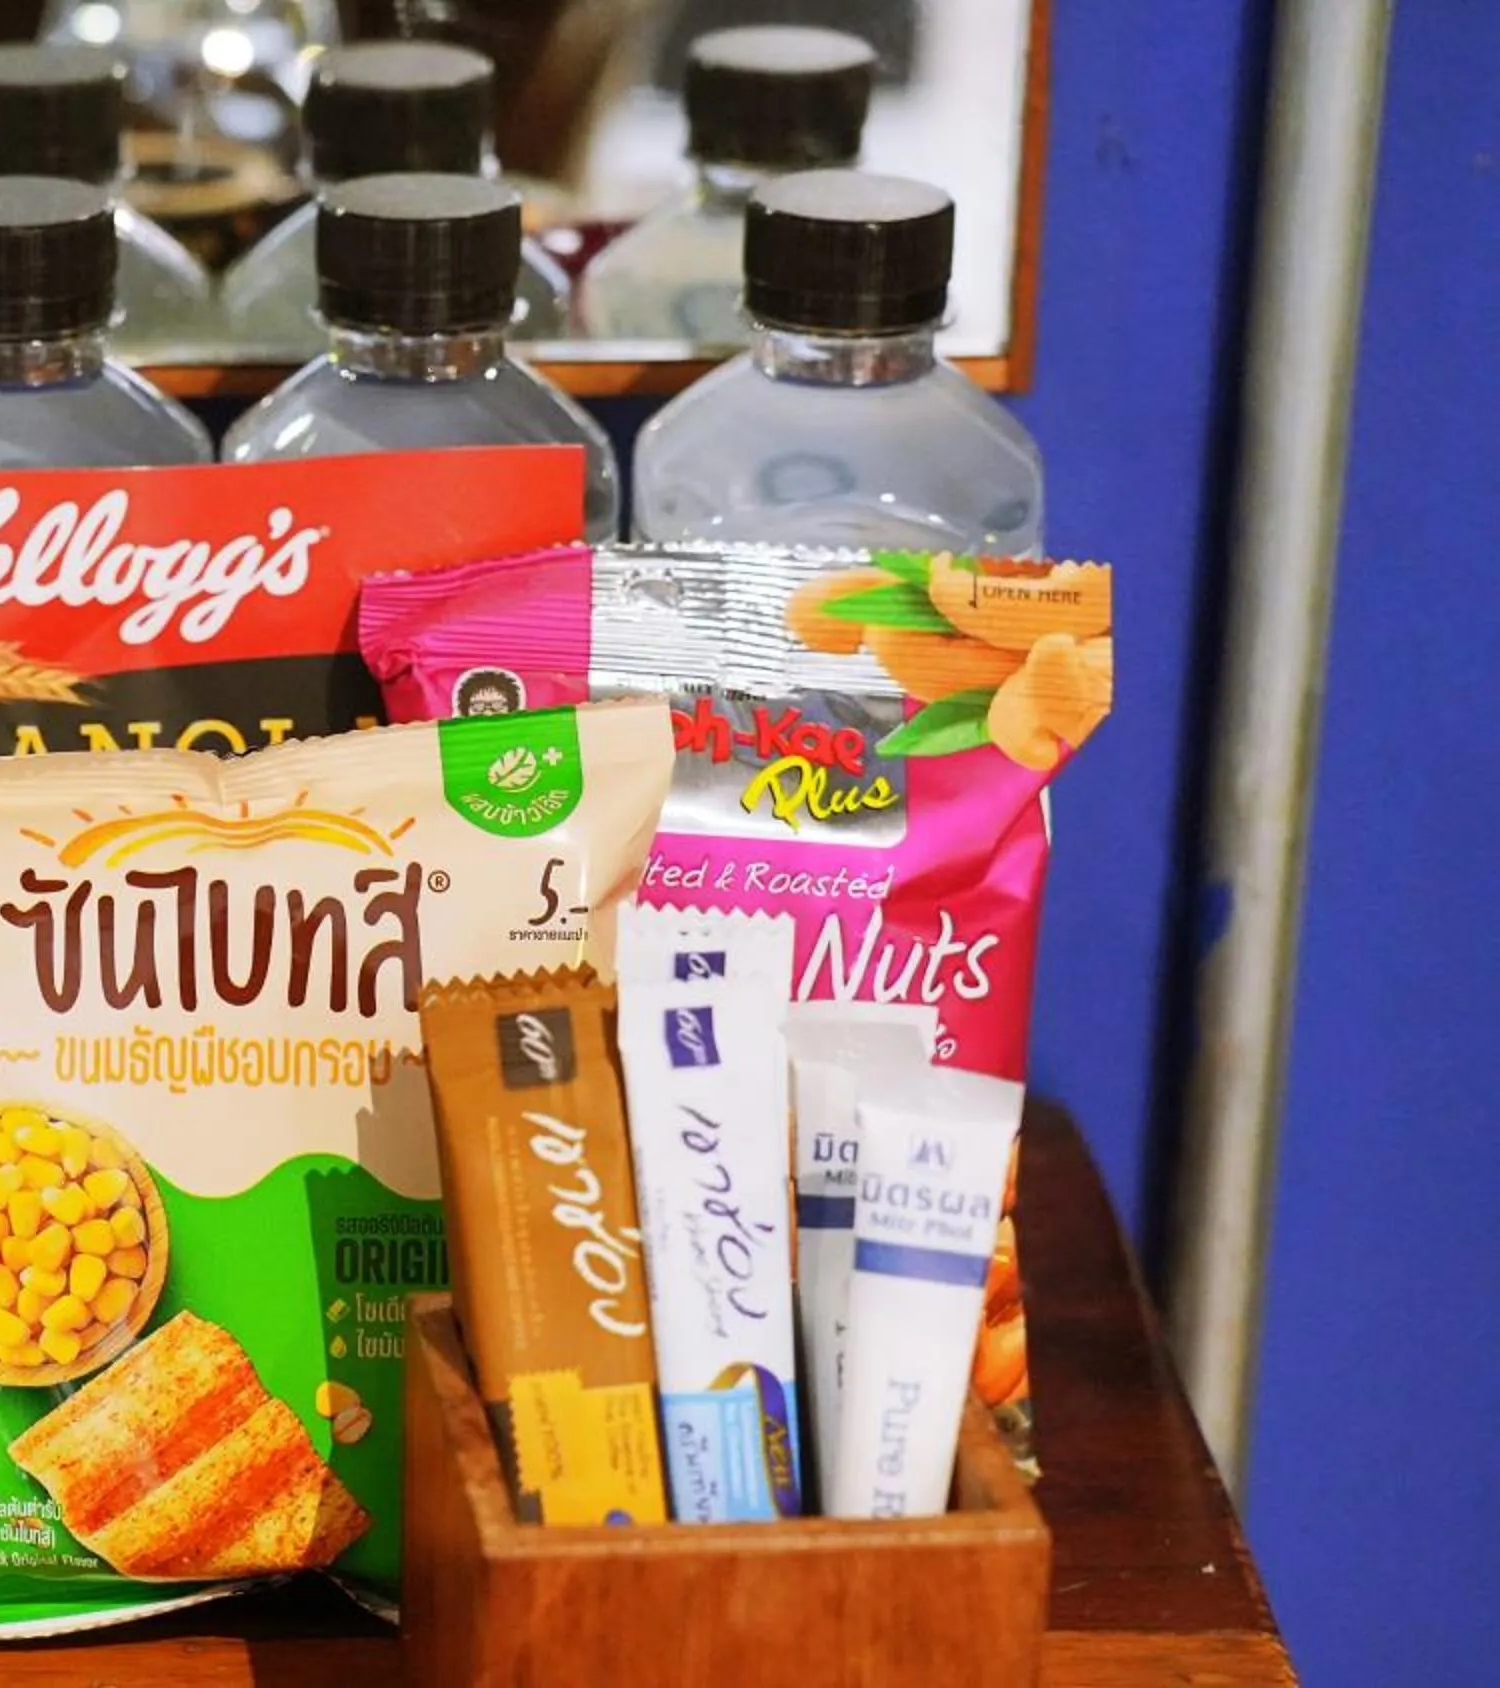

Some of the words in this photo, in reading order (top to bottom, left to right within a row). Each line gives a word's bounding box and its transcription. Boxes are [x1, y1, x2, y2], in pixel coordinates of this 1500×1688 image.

[982, 585, 1031, 601] OPEN
[1038, 588, 1083, 604] HERE
[739, 754, 899, 834] Plus
[638, 855, 709, 888] lted
[714, 861, 737, 893] &
[743, 862, 894, 899] Roasted
[796, 904, 1000, 1004] Nuts
[54, 1024, 392, 1093] ขนมธัญพืชอบกรอบ
[861, 1172, 991, 1219] มิตรผล
[336, 1237, 449, 1285] ORIGI
